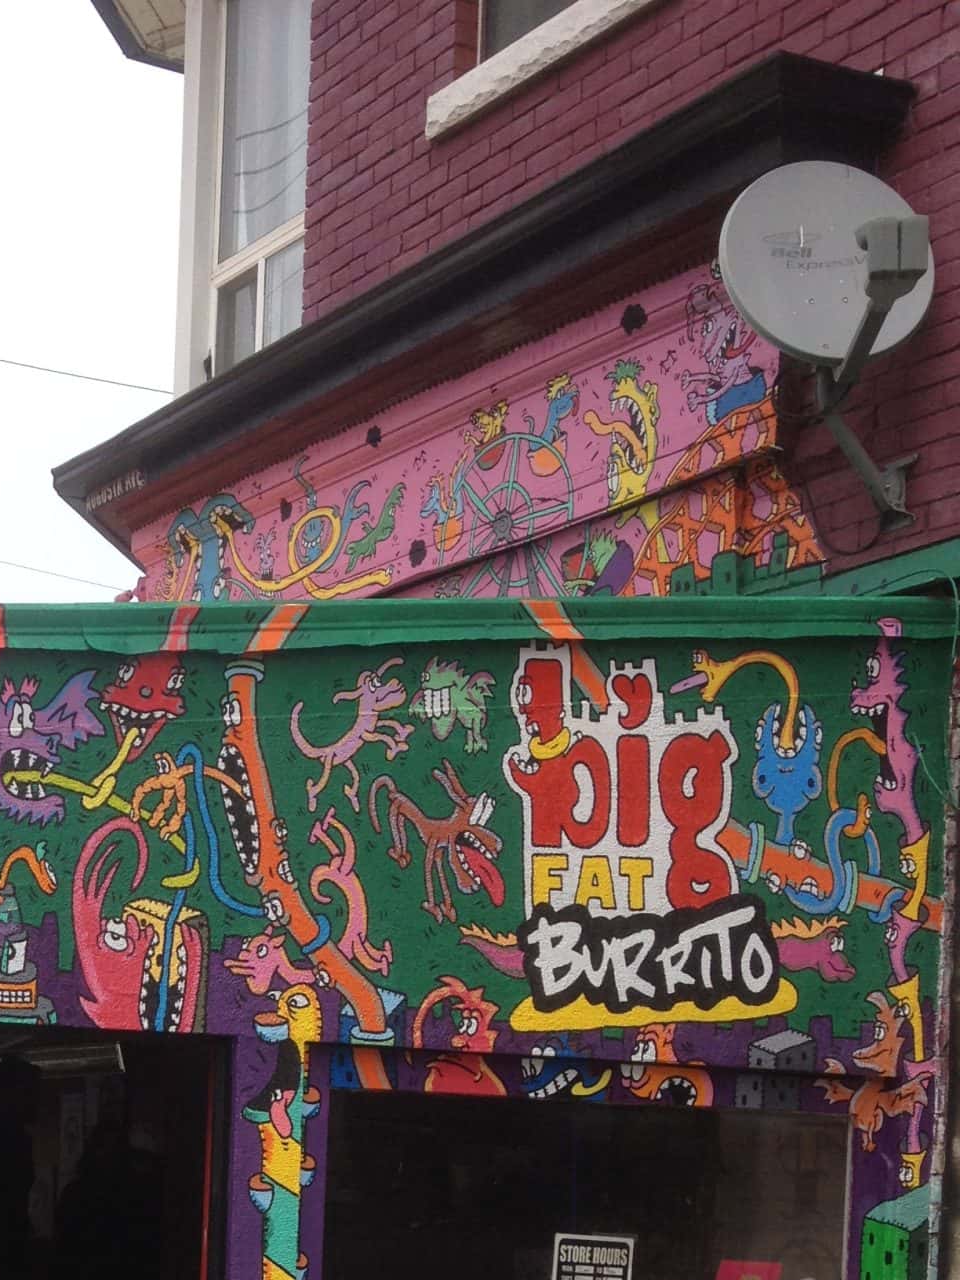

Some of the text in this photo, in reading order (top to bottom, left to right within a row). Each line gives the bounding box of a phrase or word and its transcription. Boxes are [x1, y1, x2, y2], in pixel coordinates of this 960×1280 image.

[786, 254, 865, 271] ExpressV
[531, 854, 654, 910] FAT
[527, 904, 774, 1002] BURRITO
[559, 1245, 628, 1266] STORE HOURS
